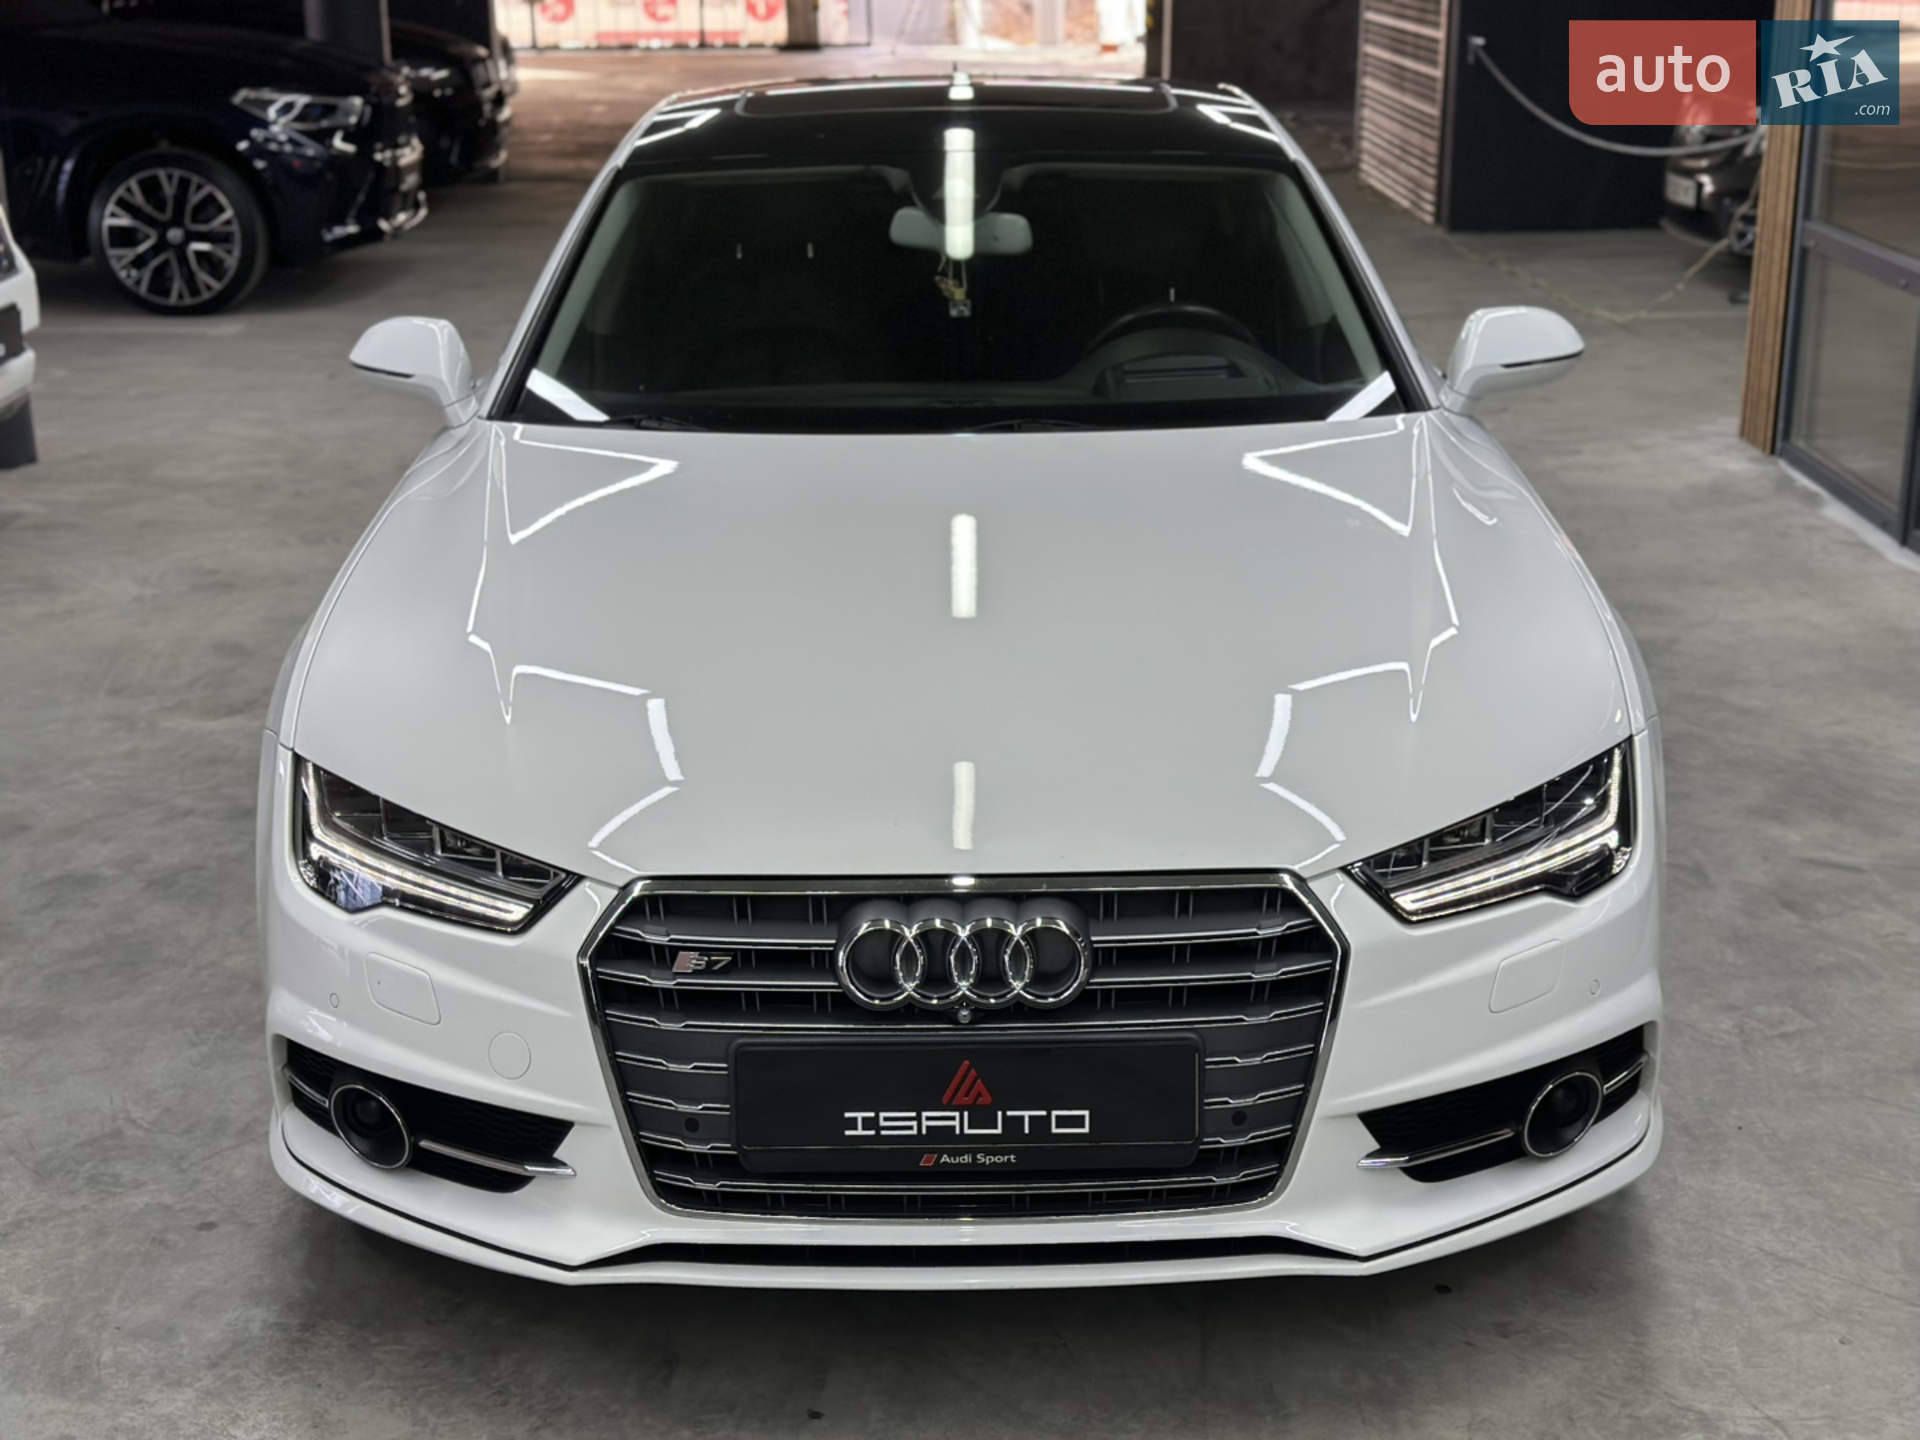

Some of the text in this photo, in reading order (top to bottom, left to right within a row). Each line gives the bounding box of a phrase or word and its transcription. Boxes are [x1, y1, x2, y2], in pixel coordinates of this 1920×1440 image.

[687, 955, 732, 970] S7
[844, 1110, 1090, 1135] ISAUTO
[940, 1153, 1017, 1165] Audi Sport
